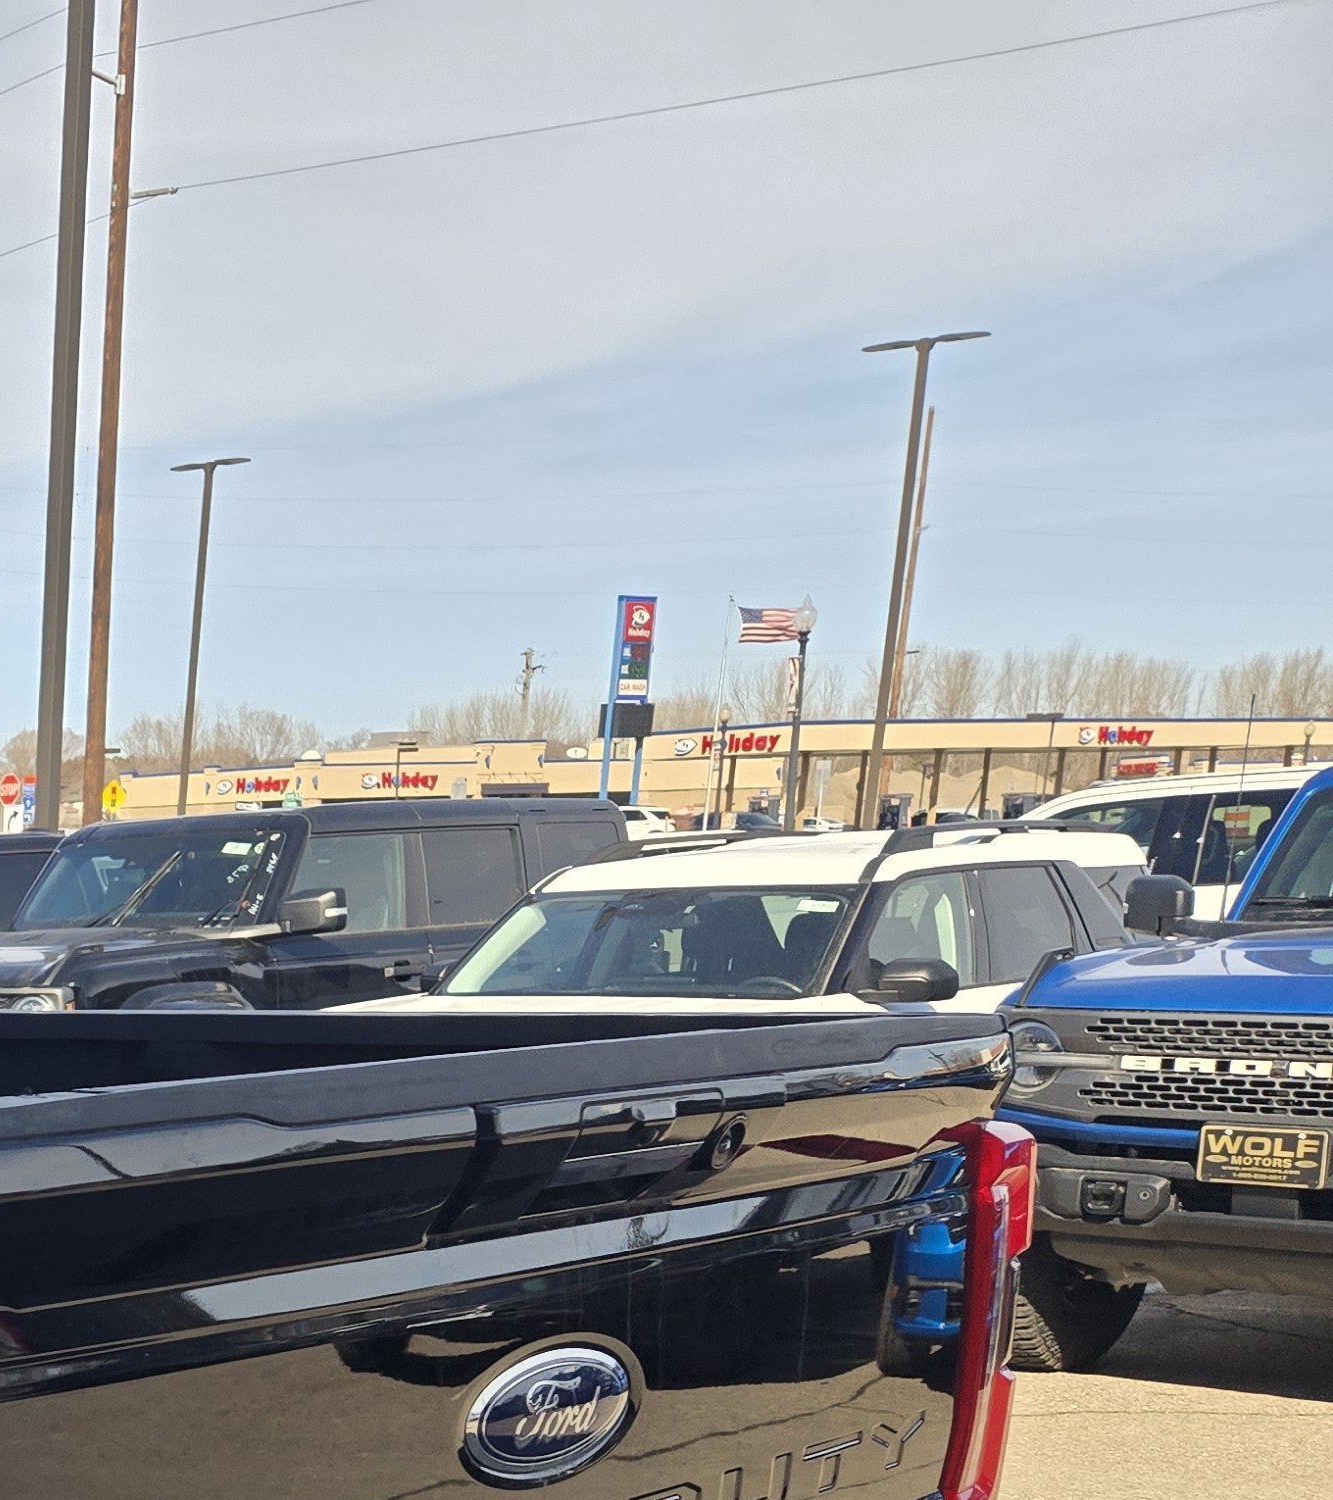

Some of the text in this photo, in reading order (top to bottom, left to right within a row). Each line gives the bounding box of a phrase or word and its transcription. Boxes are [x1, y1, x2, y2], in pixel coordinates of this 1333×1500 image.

[701, 731, 781, 755] Hliday
[1098, 725, 1154, 747] Holiday
[0, 783, 18, 797] STOP
[235, 777, 291, 794] Holiday
[381, 772, 439, 791] Holiday
[1207, 1132, 1320, 1159] WOLF
[1230, 1154, 1293, 1169] MOTORS
[514, 1376, 601, 1447] Ford
